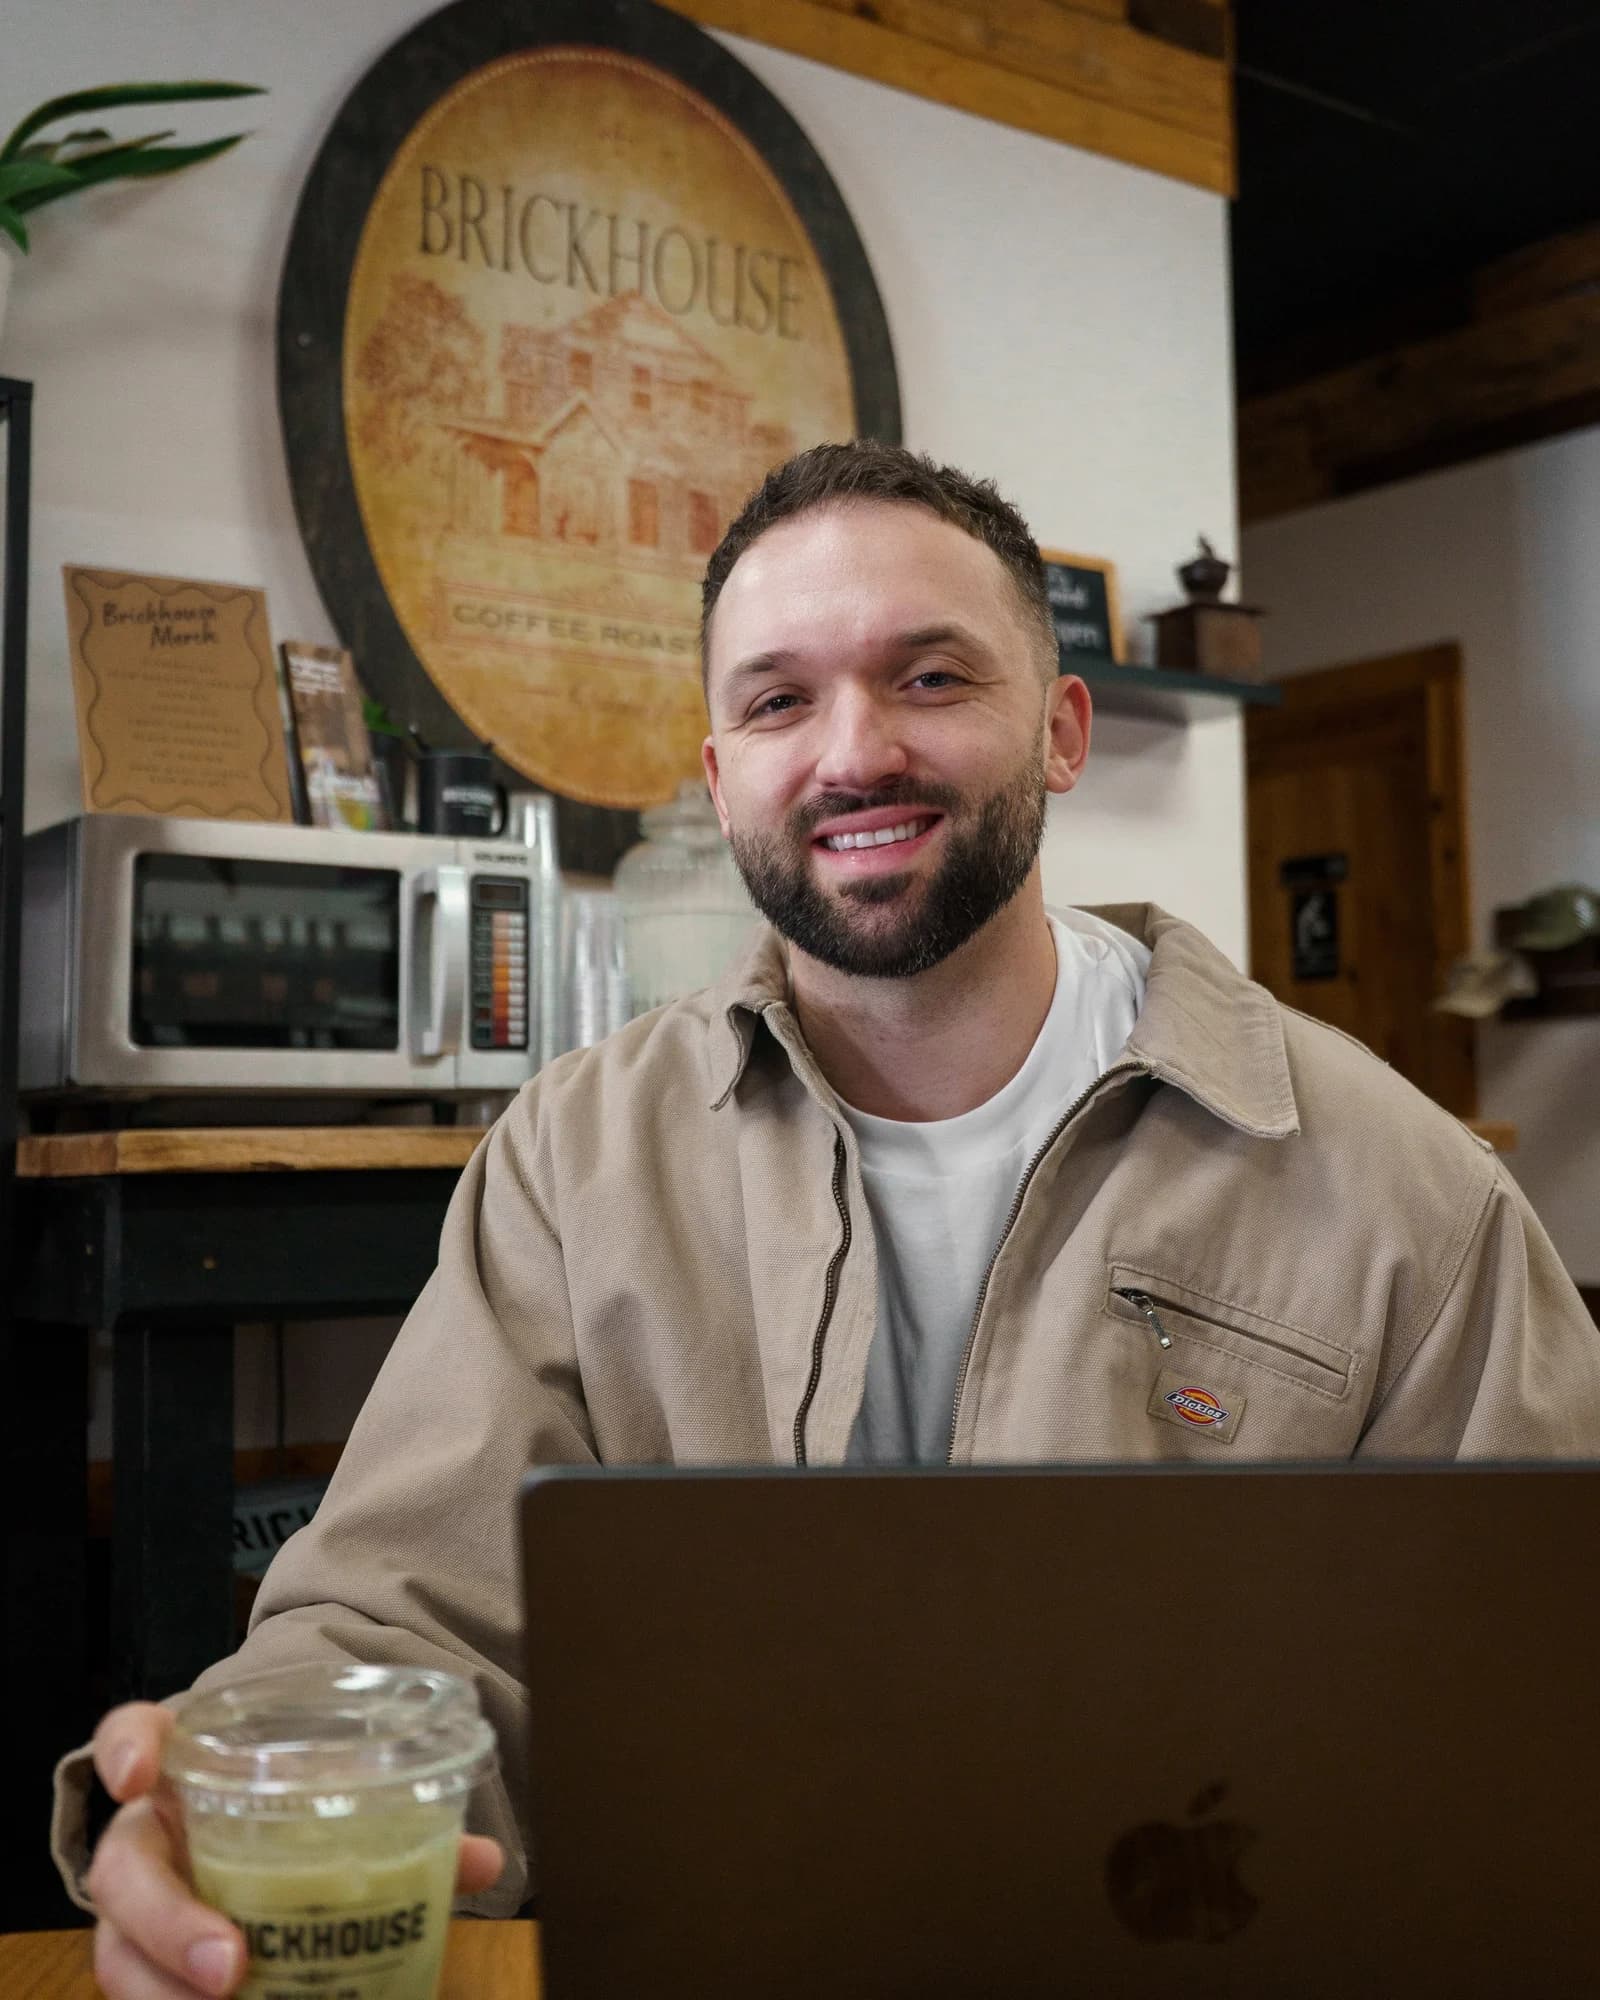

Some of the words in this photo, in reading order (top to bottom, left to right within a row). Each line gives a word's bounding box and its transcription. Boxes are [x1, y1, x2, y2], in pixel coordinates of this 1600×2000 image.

[418, 164, 806, 341] BRICKHOUSE
[453, 603, 589, 641] COFFEE
[1171, 1395, 1223, 1419] Dickies
[231, 1901, 427, 1960] ICKHOUSE
